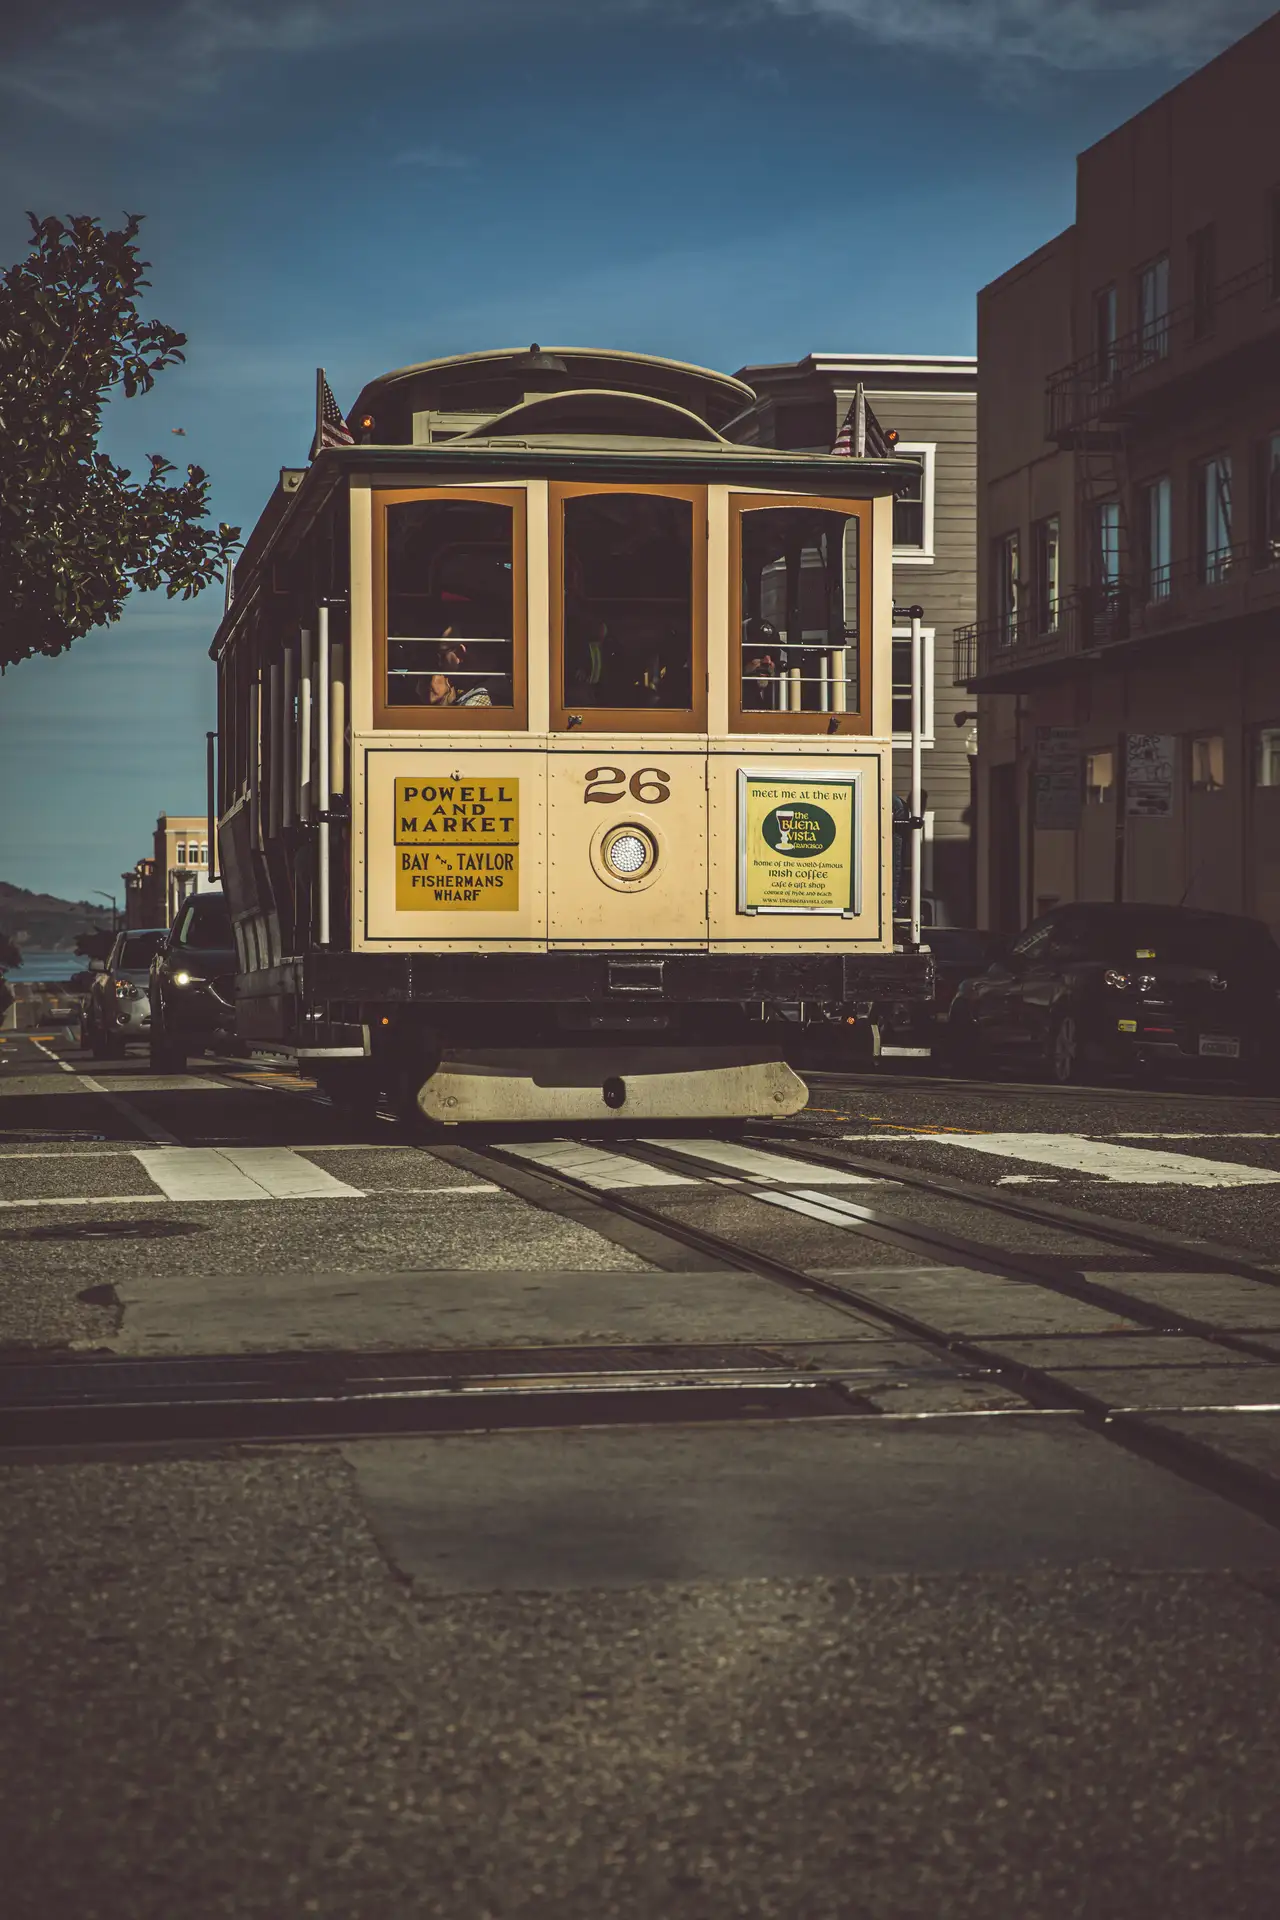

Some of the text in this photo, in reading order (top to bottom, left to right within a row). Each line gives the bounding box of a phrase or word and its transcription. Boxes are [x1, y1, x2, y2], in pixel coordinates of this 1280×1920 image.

[584, 766, 671, 804] 26
[404, 786, 513, 802] POWELL
[752, 789, 778, 798] meet
[781, 790, 797, 799] me
[813, 790, 830, 800] the
[832, 792, 847, 801] BV!
[432, 804, 486, 816] AND
[794, 811, 809, 820] the
[401, 817, 514, 832] MARKET
[402, 853, 514, 871] BAY AND TAYLOR
[412, 875, 504, 887] FISHERMANS
[434, 889, 481, 901] WHARF
